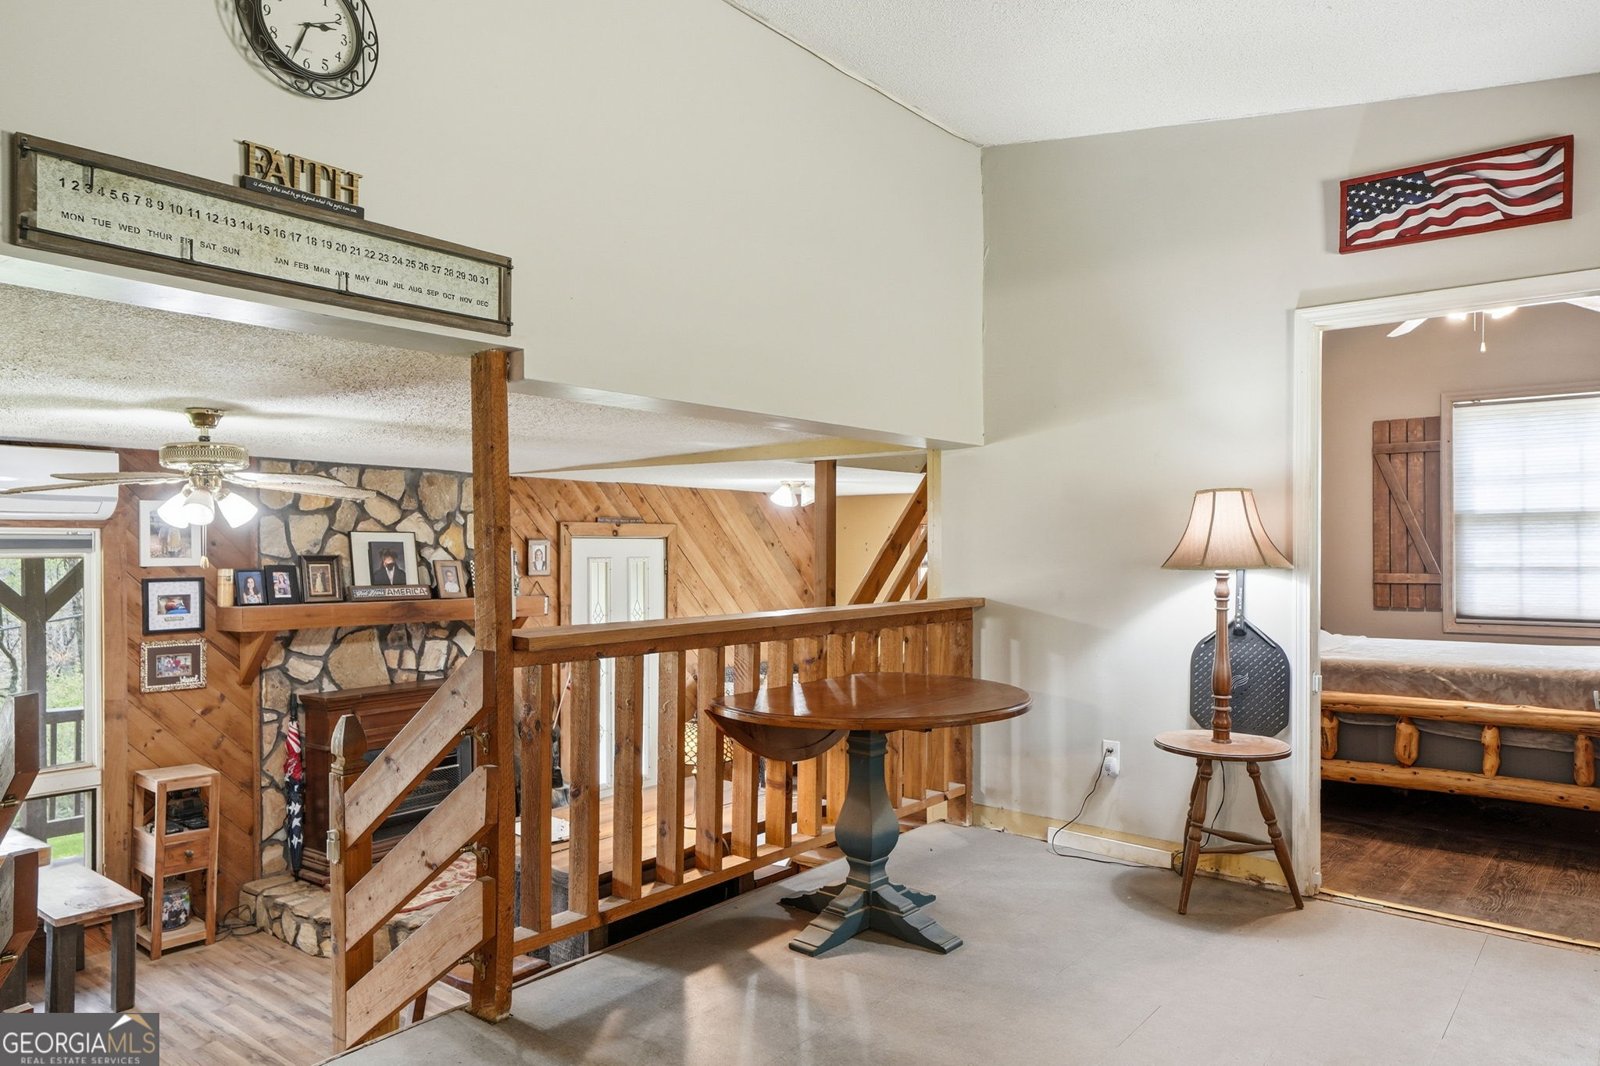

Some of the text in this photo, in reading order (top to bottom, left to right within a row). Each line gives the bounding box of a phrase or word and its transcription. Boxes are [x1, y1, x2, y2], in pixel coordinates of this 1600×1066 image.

[263, 4, 271, 16] 9
[335, 14, 342, 25] 2
[269, 26, 278, 39] 8
[340, 34, 348, 46] 3
[285, 45, 292, 57] 7
[335, 51, 342, 62] 4
[303, 58, 311, 70] 6
[322, 59, 329, 71] 5
[242, 140, 363, 206] FAITH
[59, 178, 489, 285] 1 2 3 4 5 6 7 8 9 10 11 12 13 14 15 16 17 18 19 20 21 22 23 24 25 26 27 28 29 30 31
[61, 211, 85, 222] MON
[92, 217, 111, 228] TUE
[118, 223, 140, 234] WED
[147, 229, 173, 241] THUR
[200, 241, 217, 250] SAT
[222, 246, 240, 256] SUN
[274, 257, 289, 266] JAN
[294, 261, 309, 270] FEB
[314, 265, 330, 275] MAR
[355, 274, 370, 283] MAY
[375, 278, 388, 287] JUN
[393, 282, 404, 290] JUL
[409, 285, 423, 294] AUG
[427, 289, 439, 297] SEP
[443, 292, 455, 300] OCT
[460, 296, 472, 304] NOV
[477, 299, 489, 307] DEC
[387, 588, 425, 596] AMERICA
